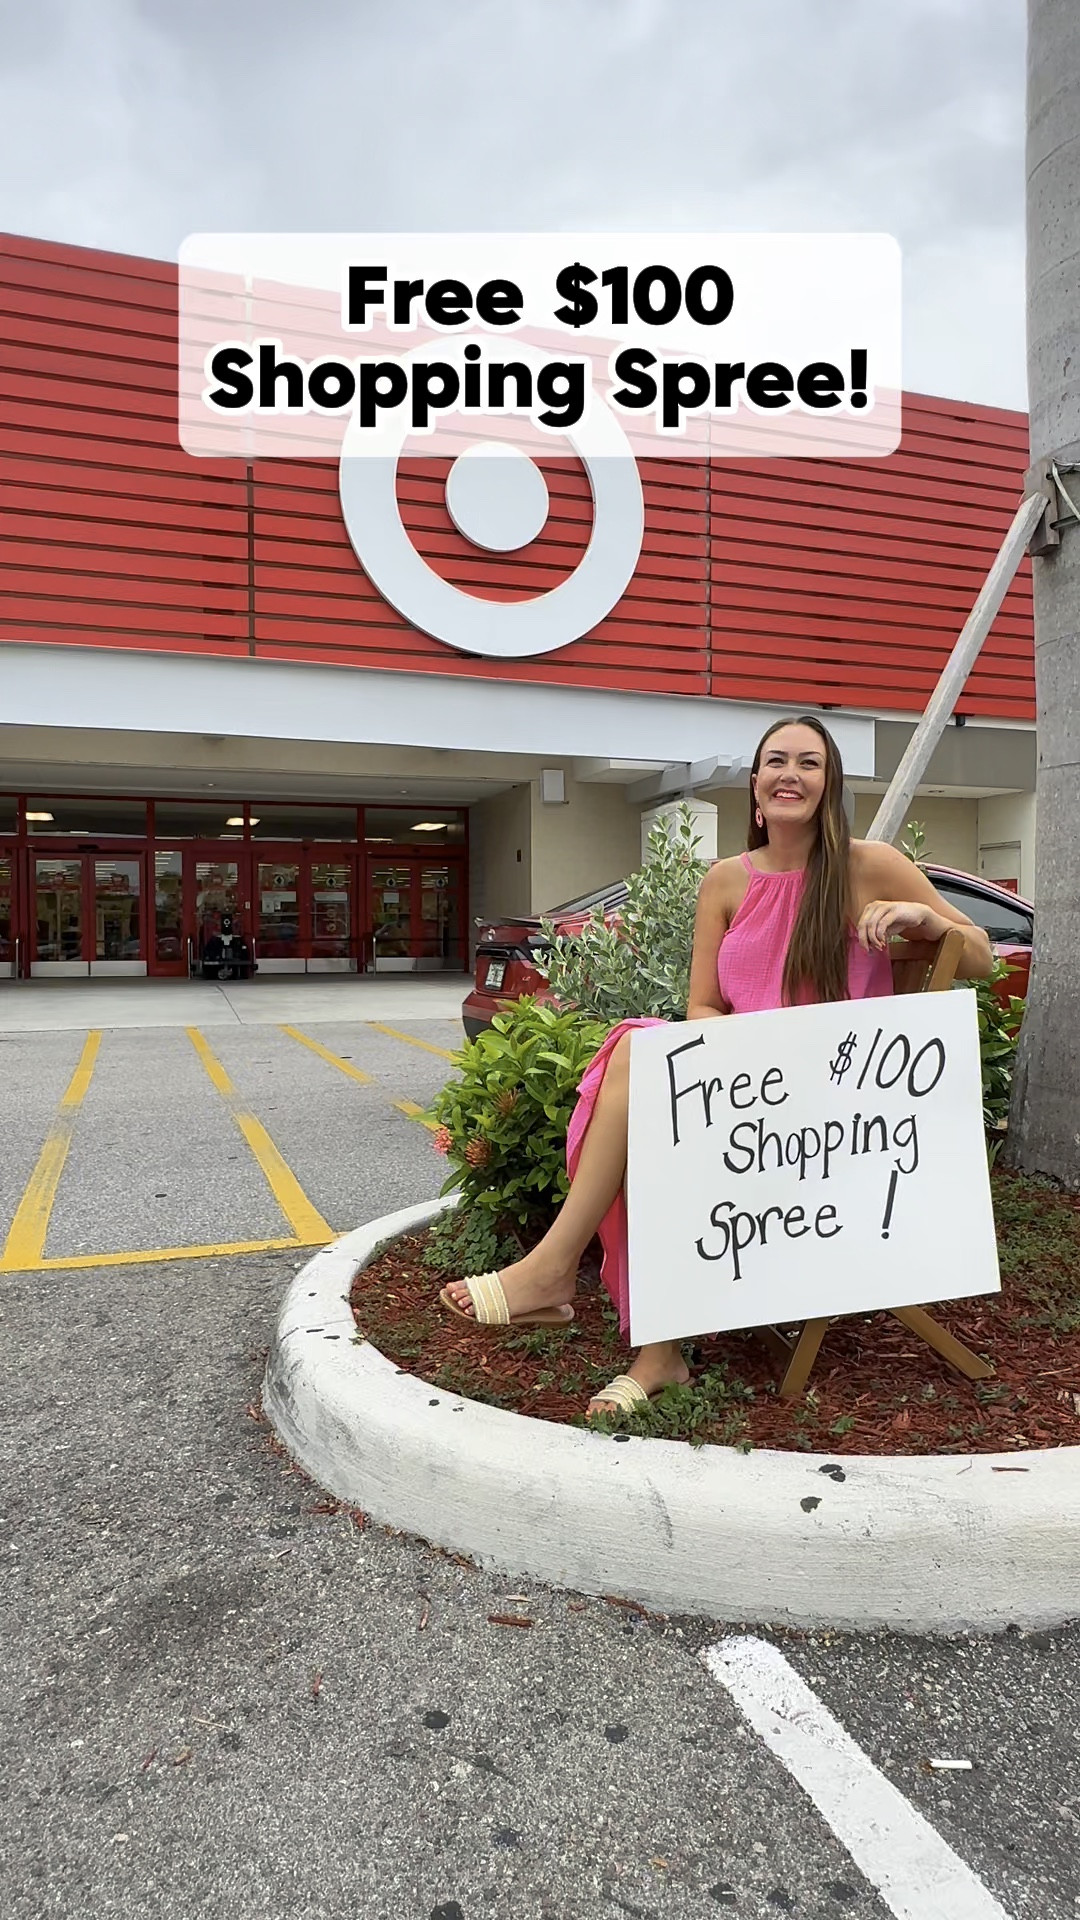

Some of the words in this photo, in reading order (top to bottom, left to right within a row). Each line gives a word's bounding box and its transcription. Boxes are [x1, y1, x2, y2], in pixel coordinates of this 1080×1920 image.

[665, 1033, 790, 1147] Free
[828, 1028, 946, 1098] $100
[722, 1112, 920, 1181] Shopping
[694, 1200, 844, 1282] Spree
